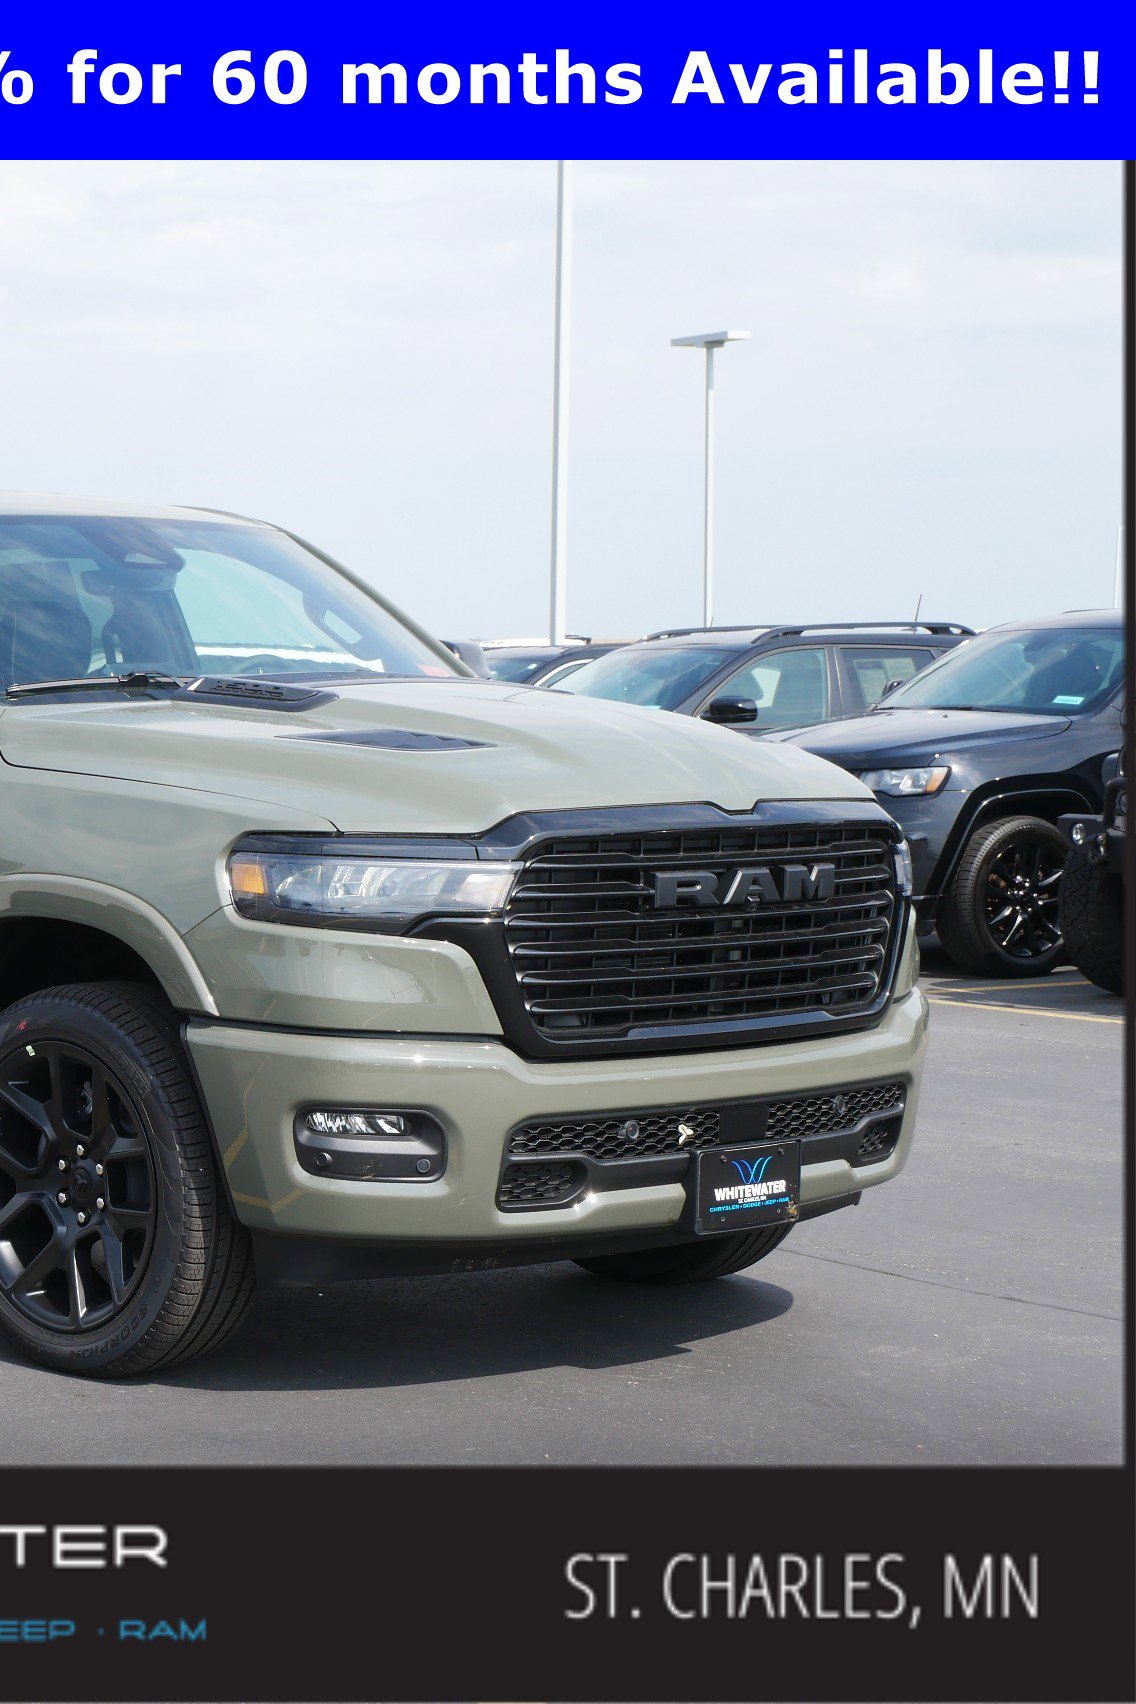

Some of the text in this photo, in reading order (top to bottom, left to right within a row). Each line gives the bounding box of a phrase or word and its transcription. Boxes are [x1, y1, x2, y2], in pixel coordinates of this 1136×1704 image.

[651, 862, 836, 908] RAM
[714, 1179, 786, 1201] WHITEWATER
[709, 1204, 740, 1213] CHRYSLER
[742, 1201, 762, 1209] DODGE
